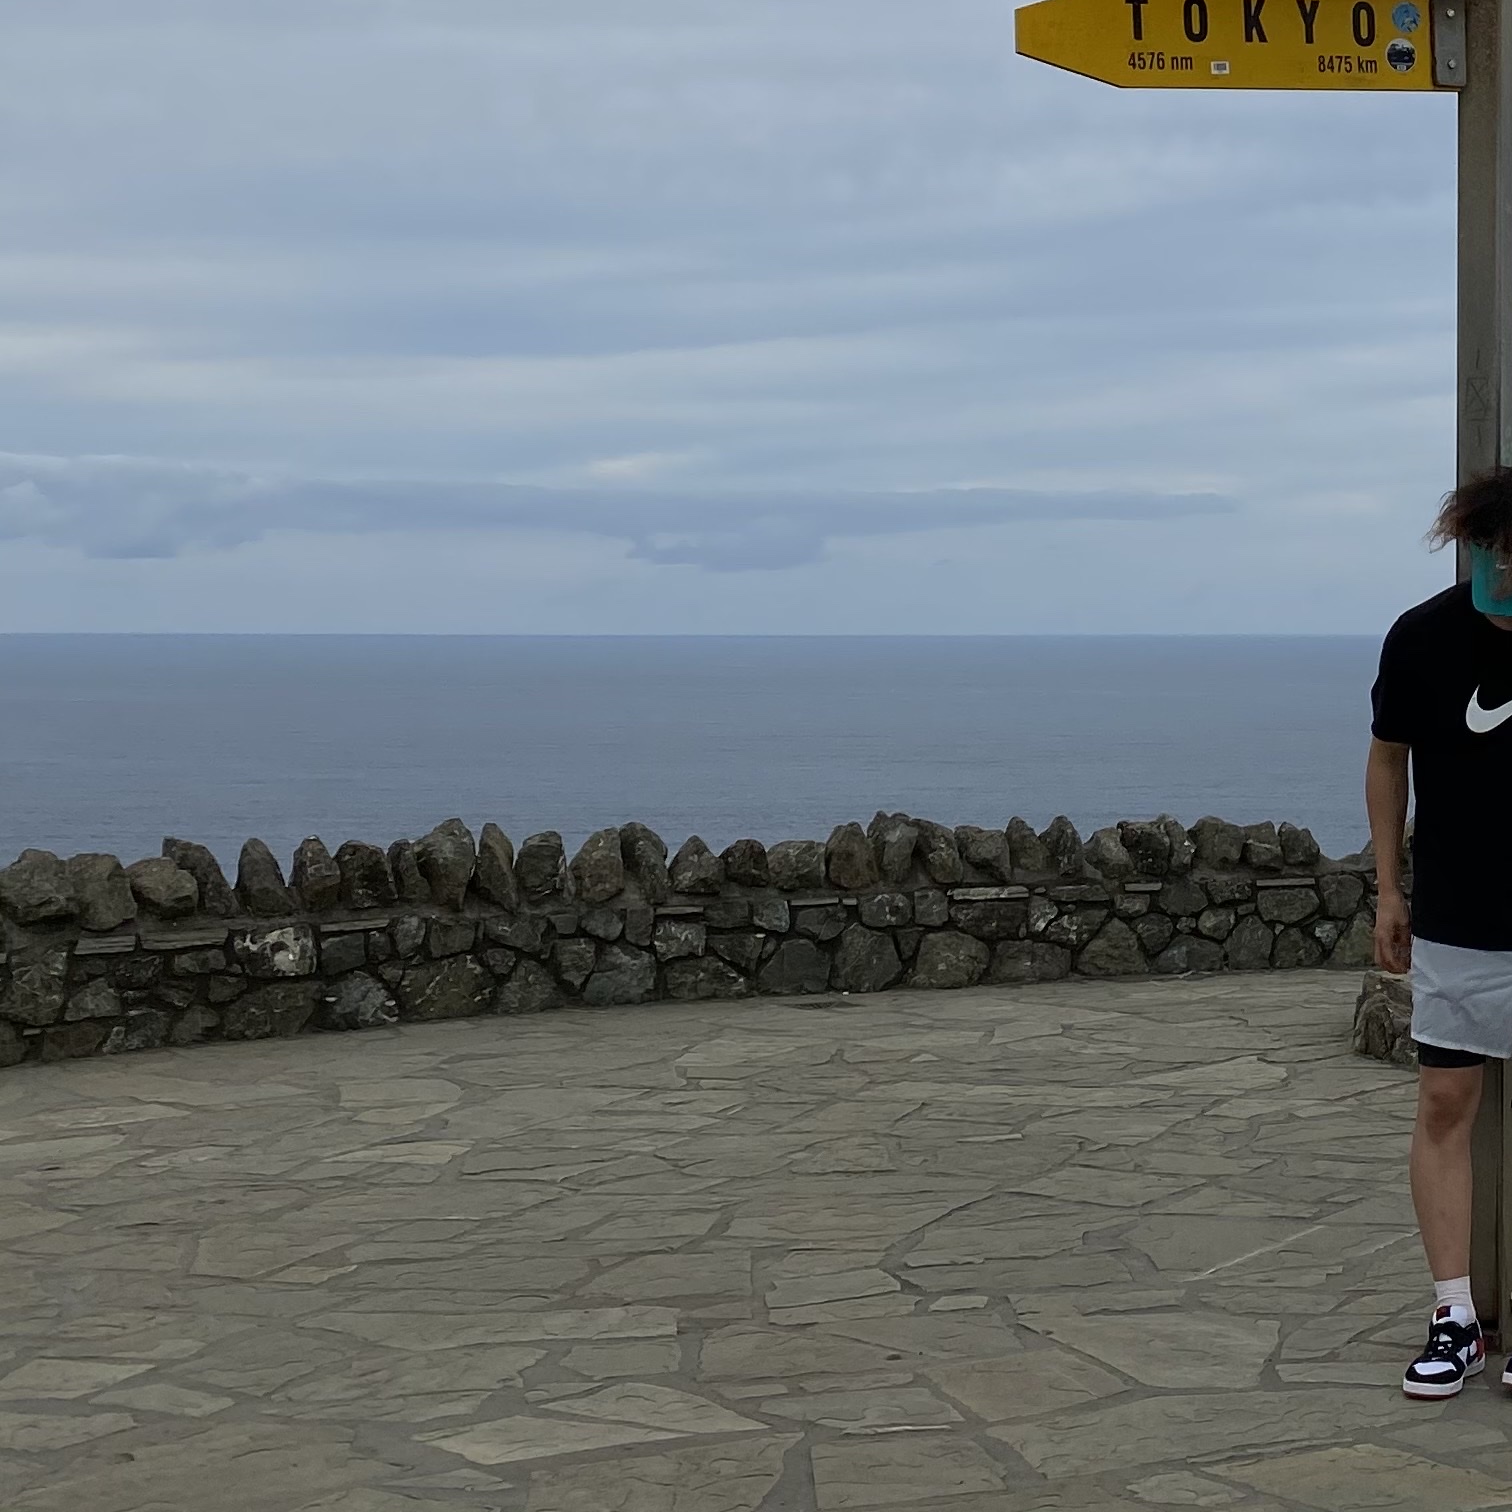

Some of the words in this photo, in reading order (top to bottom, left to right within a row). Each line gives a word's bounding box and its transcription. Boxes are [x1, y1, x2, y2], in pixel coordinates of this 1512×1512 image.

[1128, 51, 1165, 71] 4576
[1170, 55, 1193, 71] nm
[1317, 55, 1353, 74] 8475
[1357, 55, 1378, 74] km
